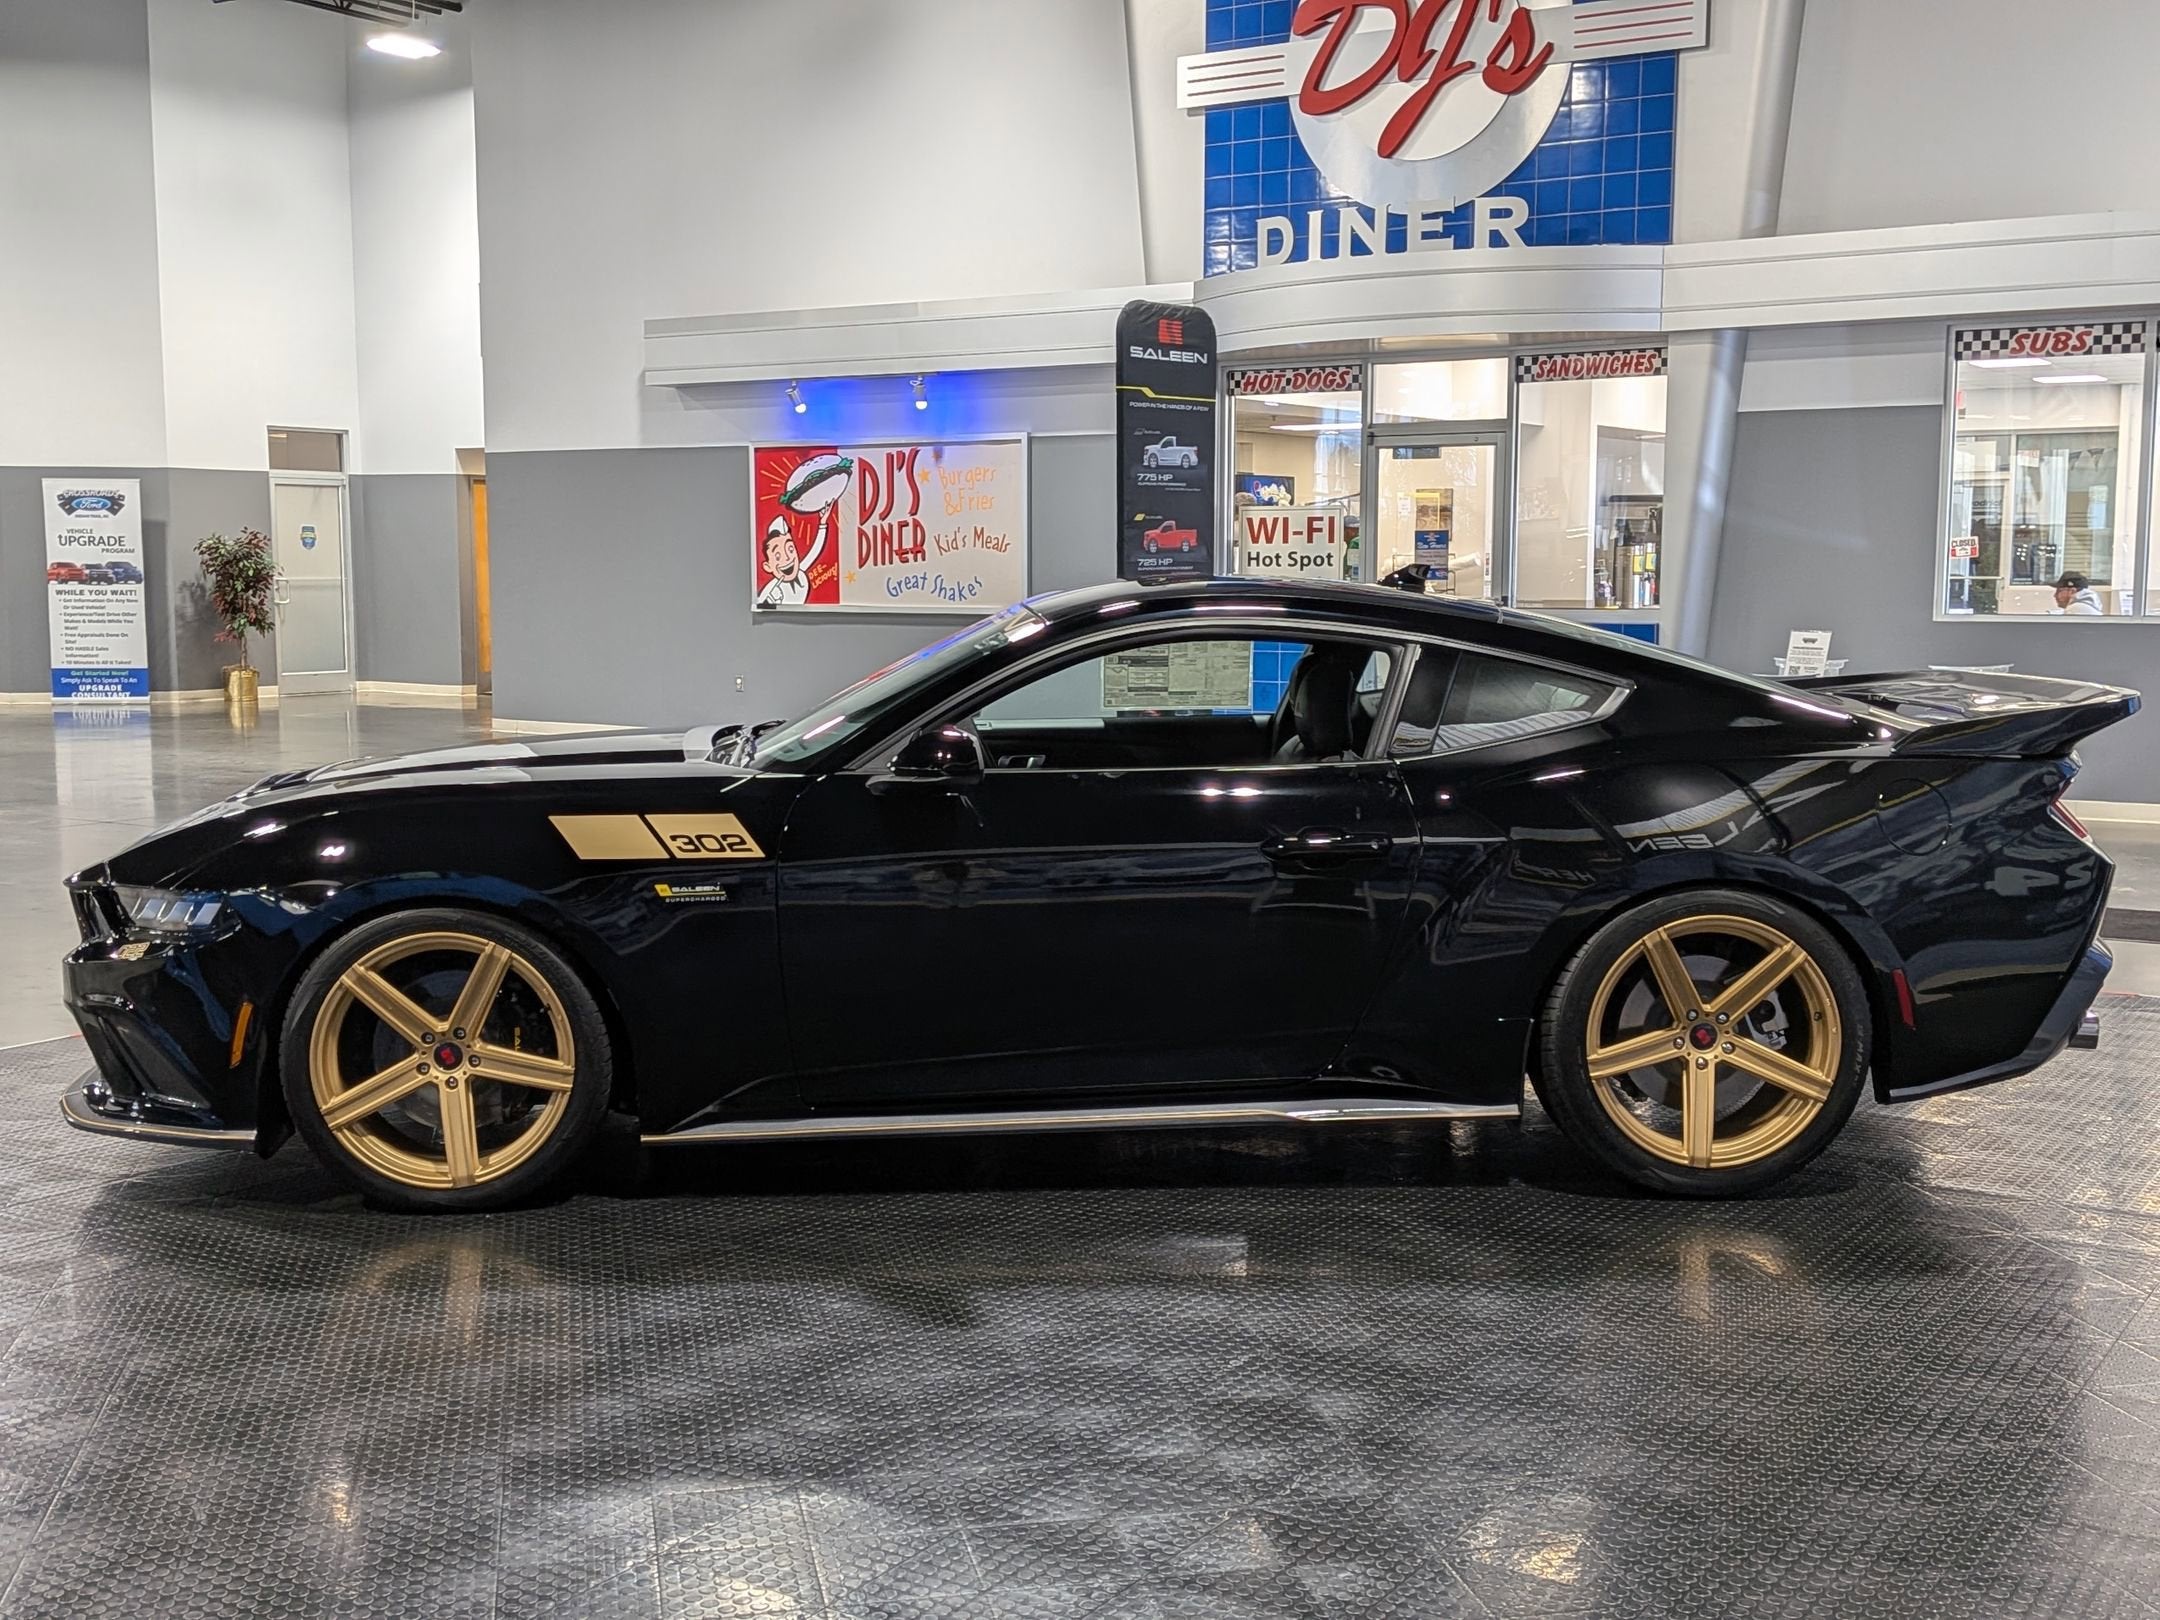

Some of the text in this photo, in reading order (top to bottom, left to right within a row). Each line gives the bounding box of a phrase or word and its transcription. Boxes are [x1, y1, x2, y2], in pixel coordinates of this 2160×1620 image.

[1292, 0, 1554, 158] DJ's
[1256, 196, 1530, 269] DINER
[1130, 345, 1208, 364] SALEEN
[2009, 329, 2094, 356] SUBS
[1535, 353, 1657, 379] SANDWICHES
[1242, 369, 1350, 393] HOT DOGS
[858, 447, 921, 527] DJ'S
[1137, 473, 1173, 481] 775 HP
[79, 499, 104, 509] Ford
[57, 534, 126, 547] UPGRADE
[934, 525, 1011, 556] Kid's Meals
[1246, 516, 1335, 544] WI-FI
[857, 517, 926, 570] DINER
[1137, 558, 1157, 566] 725
[1247, 551, 1334, 571] Hot Spot
[886, 571, 983, 602] Great Shakes
[78, 684, 122, 692] UPGRADE
[669, 834, 754, 853] 302
[671, 885, 720, 893] SALEEN
